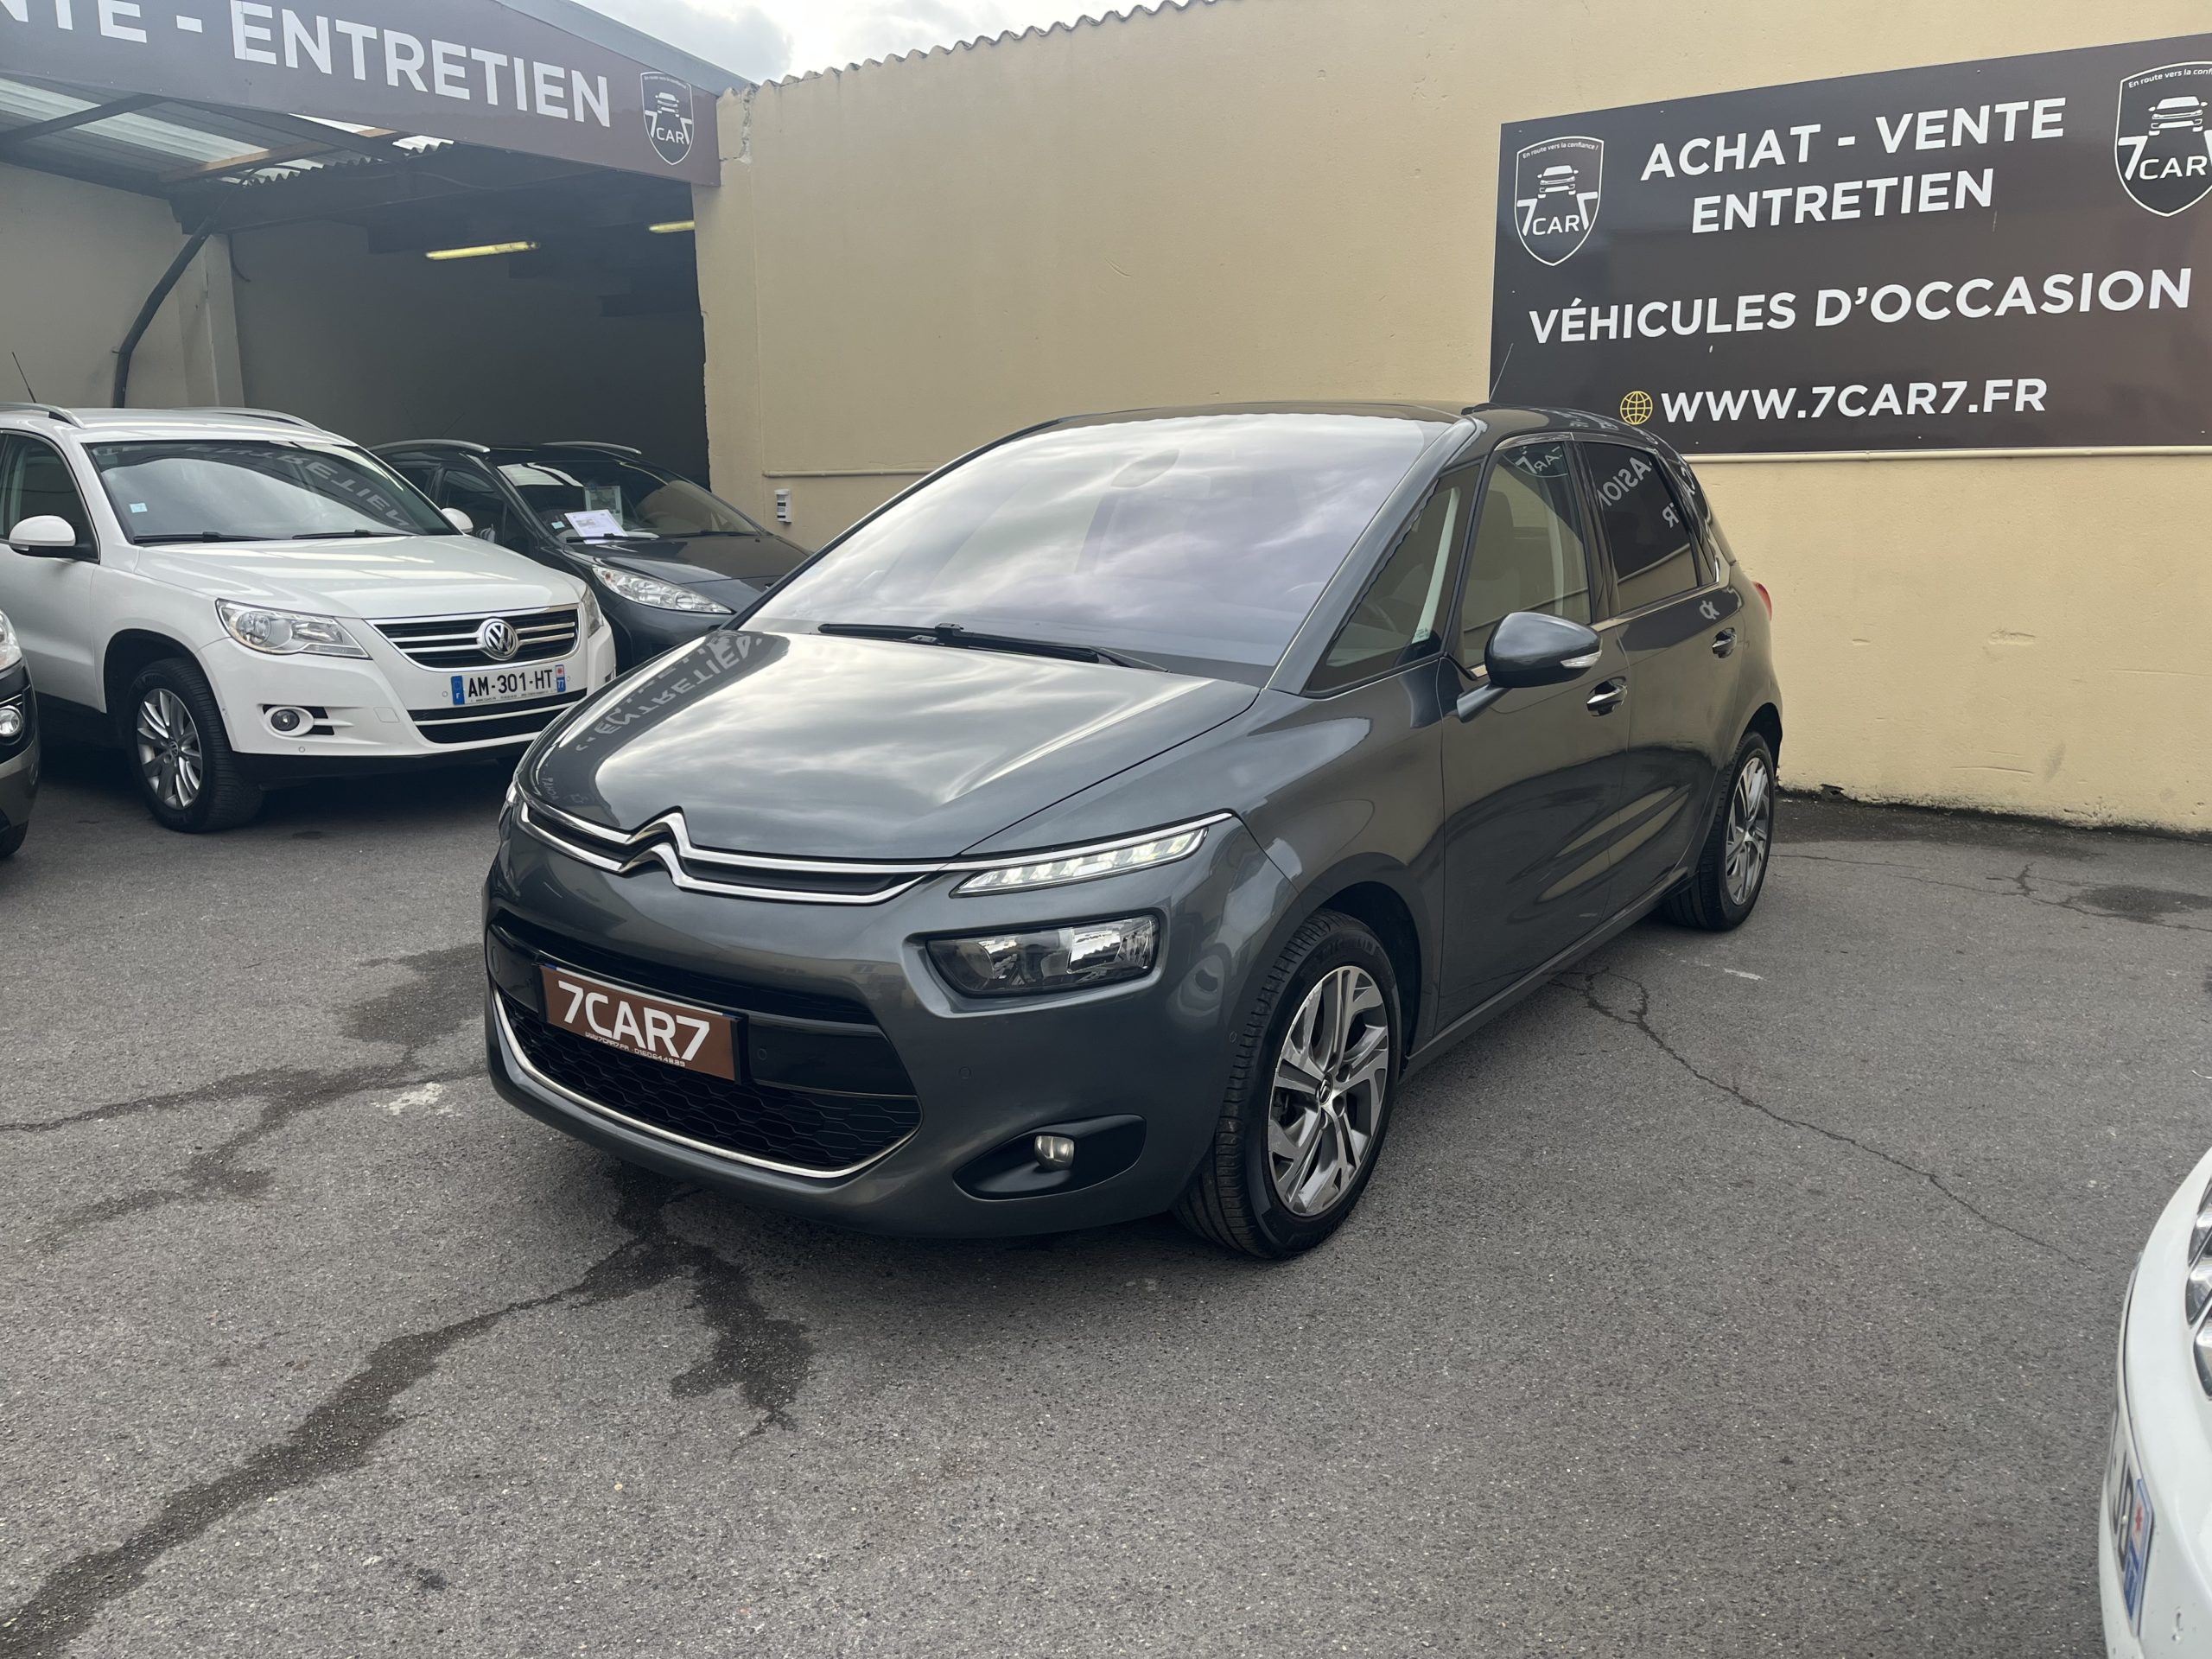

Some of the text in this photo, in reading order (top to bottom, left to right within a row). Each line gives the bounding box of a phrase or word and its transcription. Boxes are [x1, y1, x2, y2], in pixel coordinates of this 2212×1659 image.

[230, 0, 611, 128] ENTRETIEN
[2140, 73, 2163, 85] route
[2164, 69, 2183, 79] vers
[1531, 147, 1547, 156] route
[1640, 124, 1821, 181] ACHAT
[1875, 97, 2066, 154] VENTE
[1692, 168, 1994, 234] ENTRETIEN
[1529, 290, 1796, 344] VÉHICULES
[1661, 378, 2047, 423] WWW.7CAR7.FR
[467, 669, 553, 698] AM-301-HT
[558, 980, 710, 1061] 7CAR7
